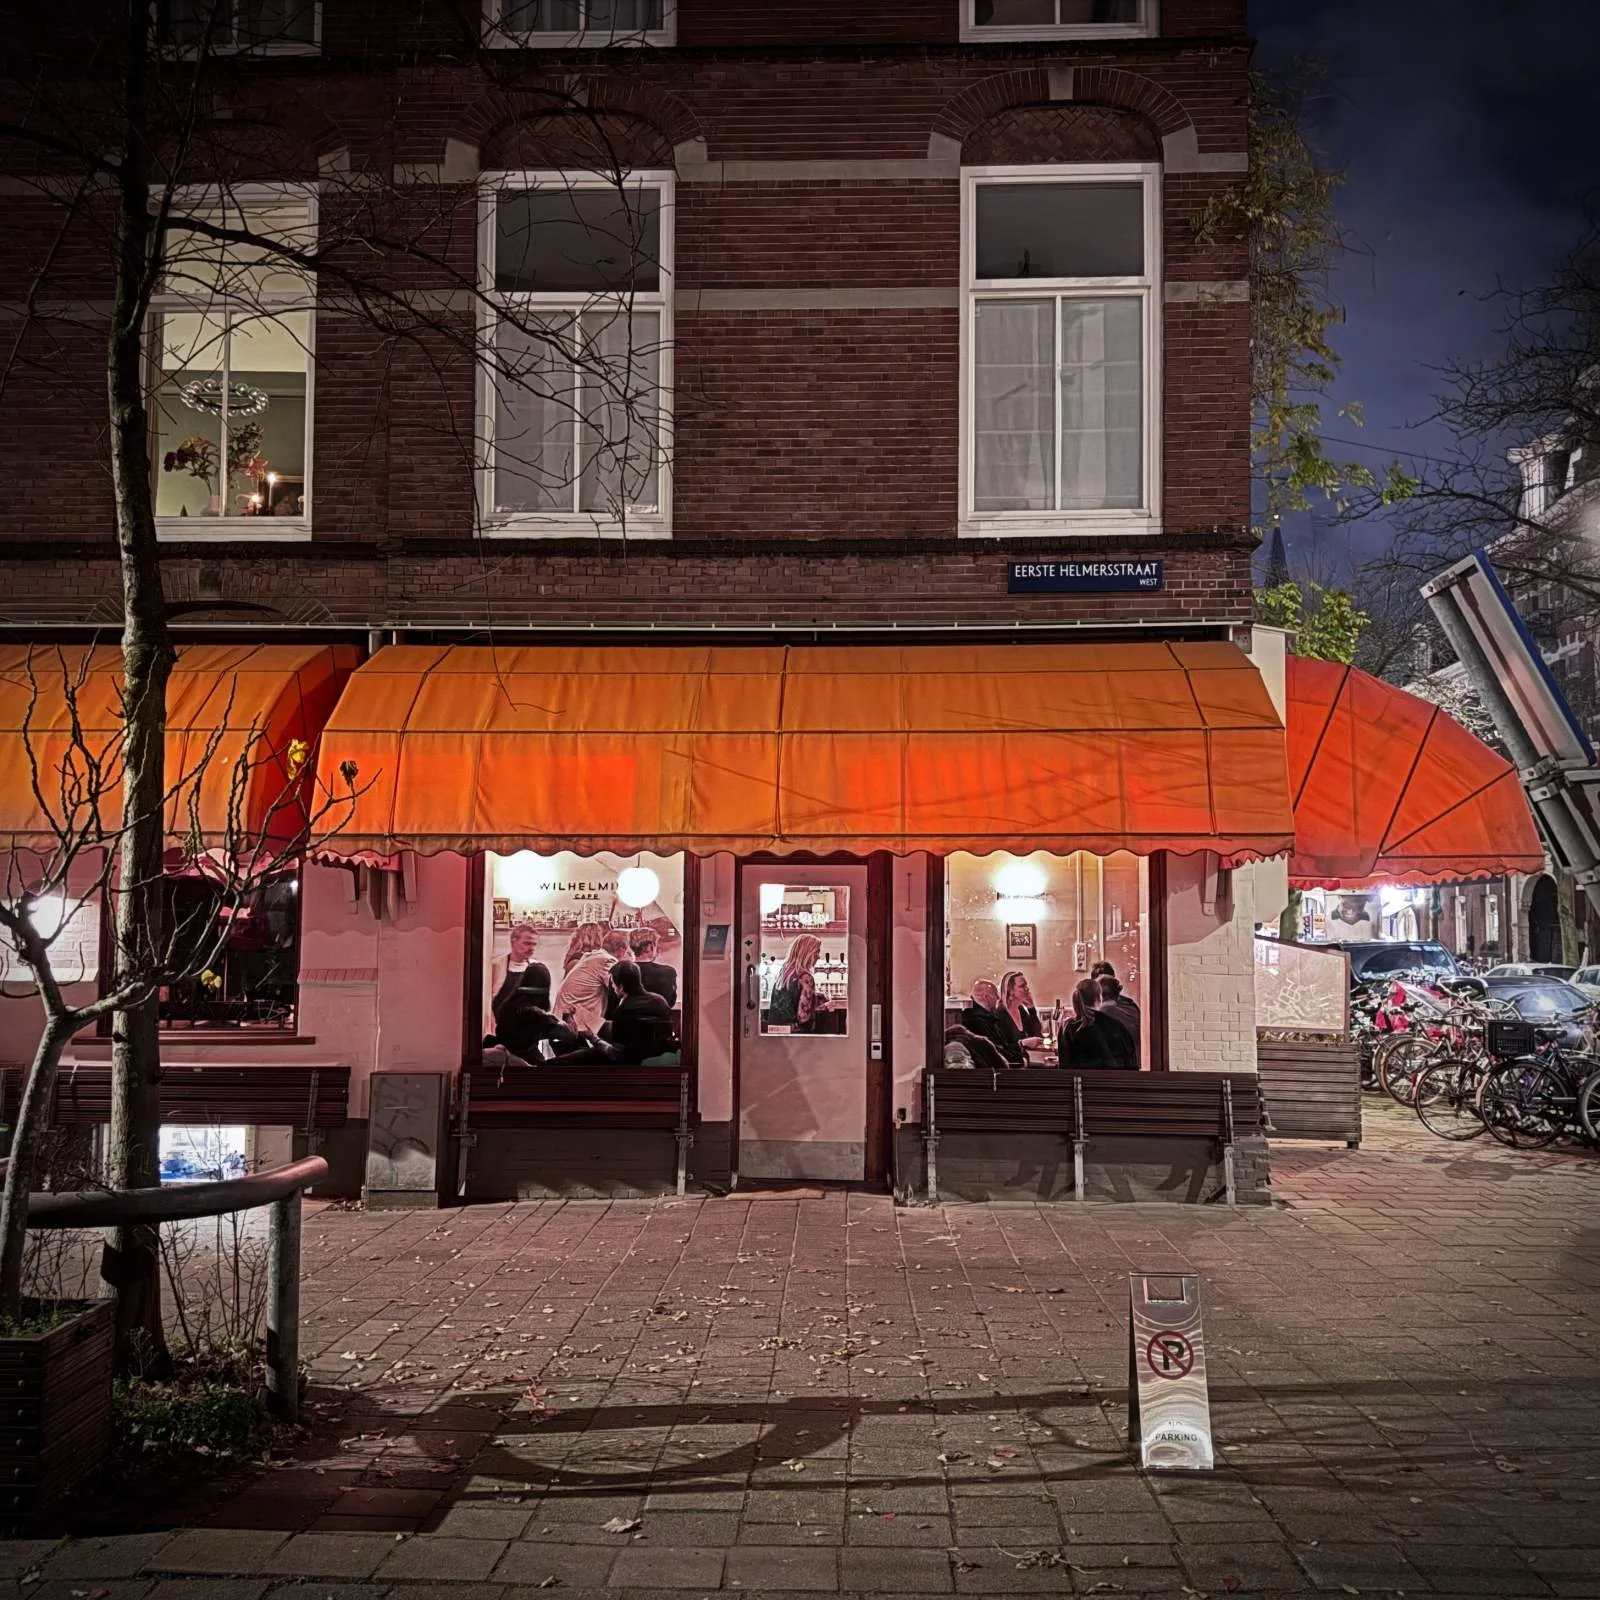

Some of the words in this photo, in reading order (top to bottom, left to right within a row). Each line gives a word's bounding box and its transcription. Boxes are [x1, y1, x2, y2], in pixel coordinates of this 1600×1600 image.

[1014, 564, 1055, 578] EERSTE
[1060, 563, 1158, 577] HELMERSSTRAAT
[1139, 578, 1158, 586] WEST
[1162, 1340, 1185, 1371] P
[1155, 1432, 1198, 1442] PARKING
